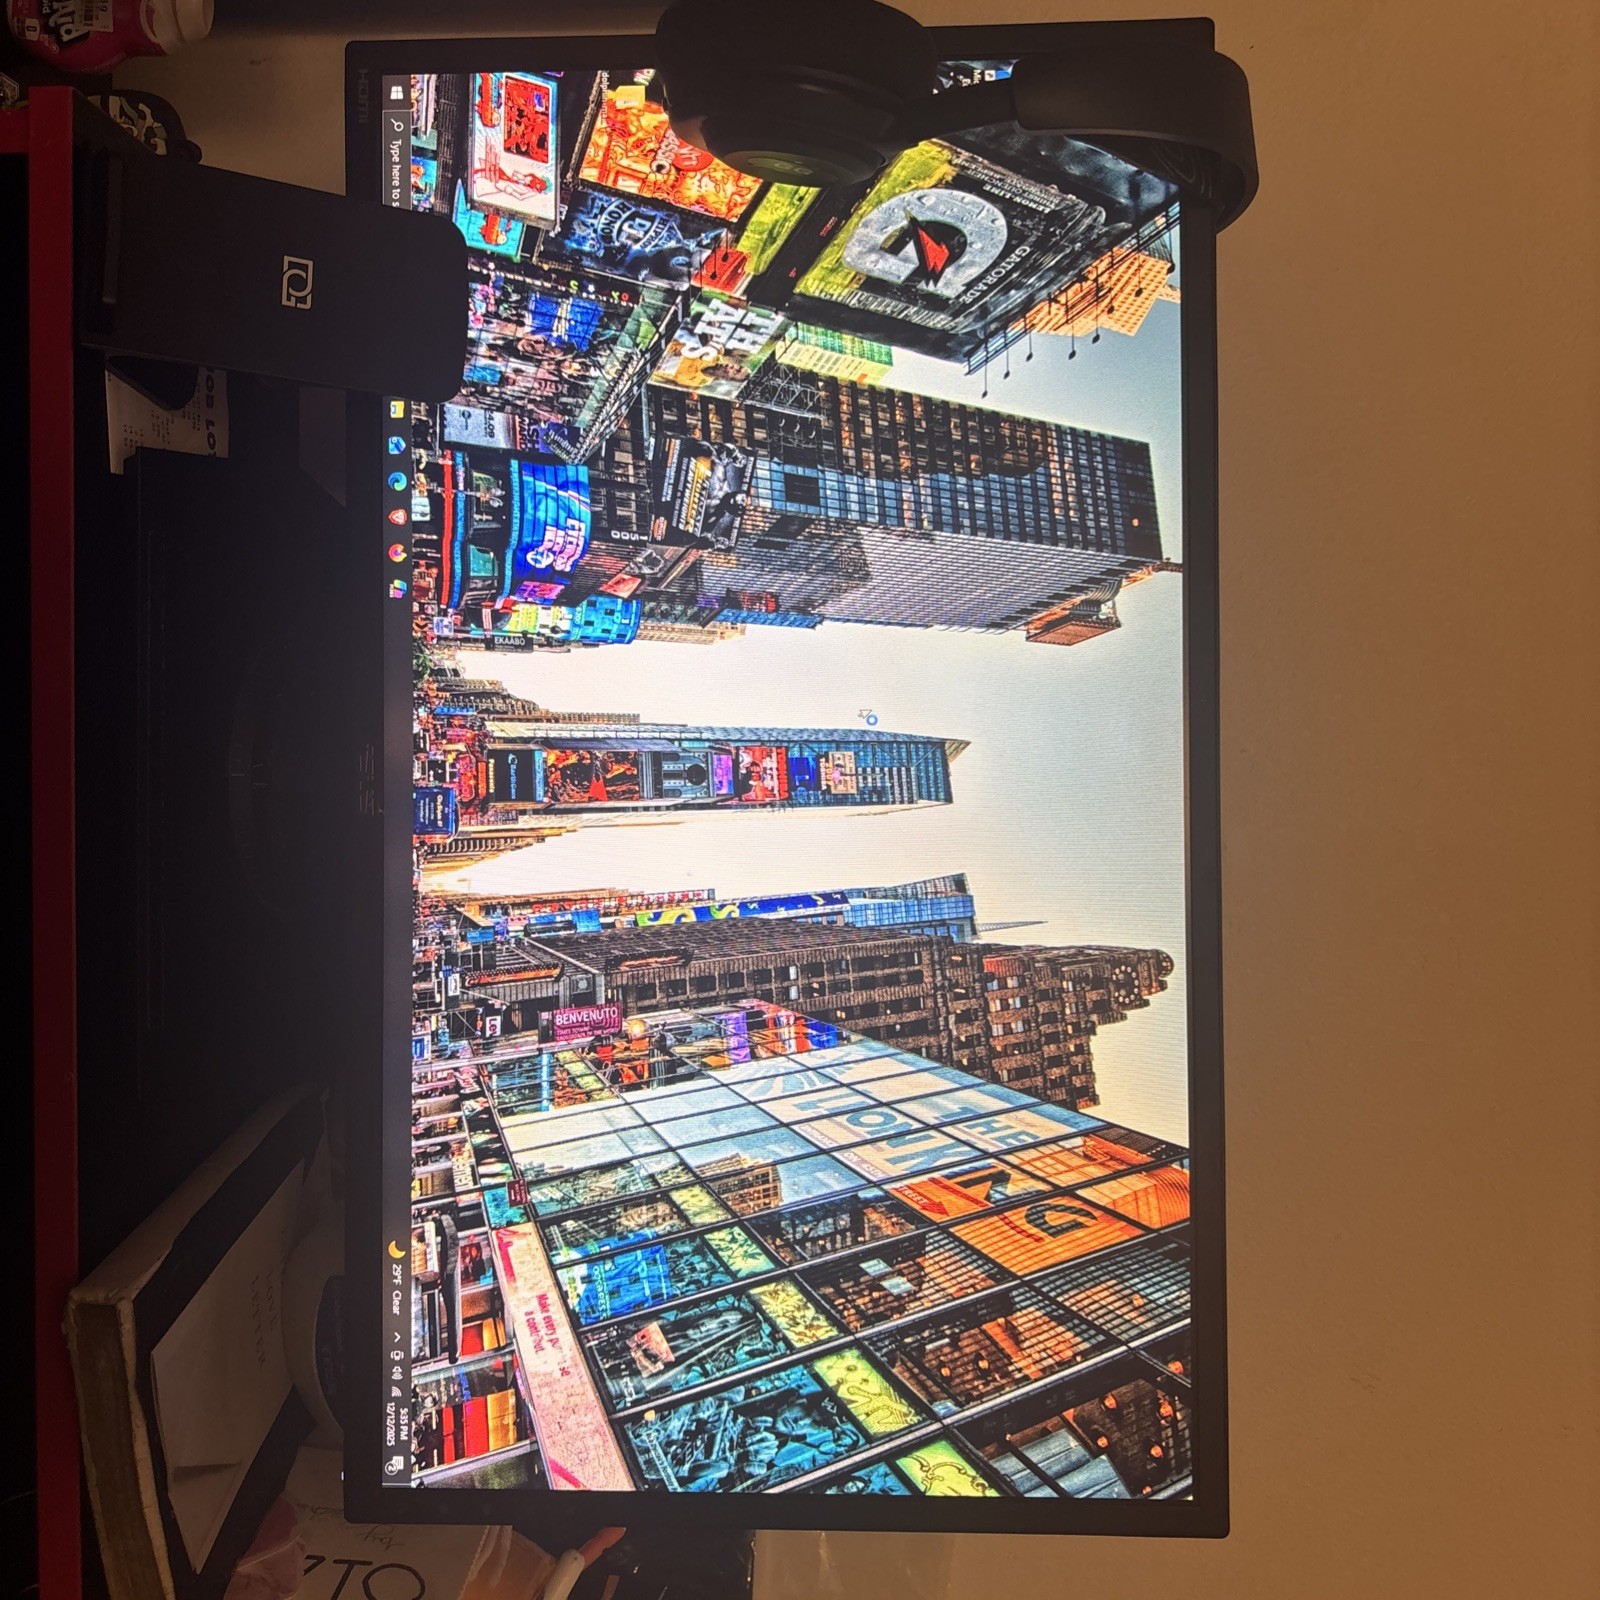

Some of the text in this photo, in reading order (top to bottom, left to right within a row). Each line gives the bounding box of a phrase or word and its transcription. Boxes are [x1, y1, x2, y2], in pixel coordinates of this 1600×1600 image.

[389, 139, 402, 162] Type
[392, 165, 403, 187] here
[392, 188, 402, 199] to
[777, 747, 788, 799] TOSHIBA
[819, 757, 827, 790] TOSHIBA
[555, 1007, 618, 1025] BENVENUTO
[392, 1264, 402, 1316] 29°F Clear
[536, 1293, 551, 1314] Make
[543, 1316, 557, 1336] every
[386, 1402, 397, 1447] 12/12/2025
[399, 1408, 409, 1440] 5:35 PM
